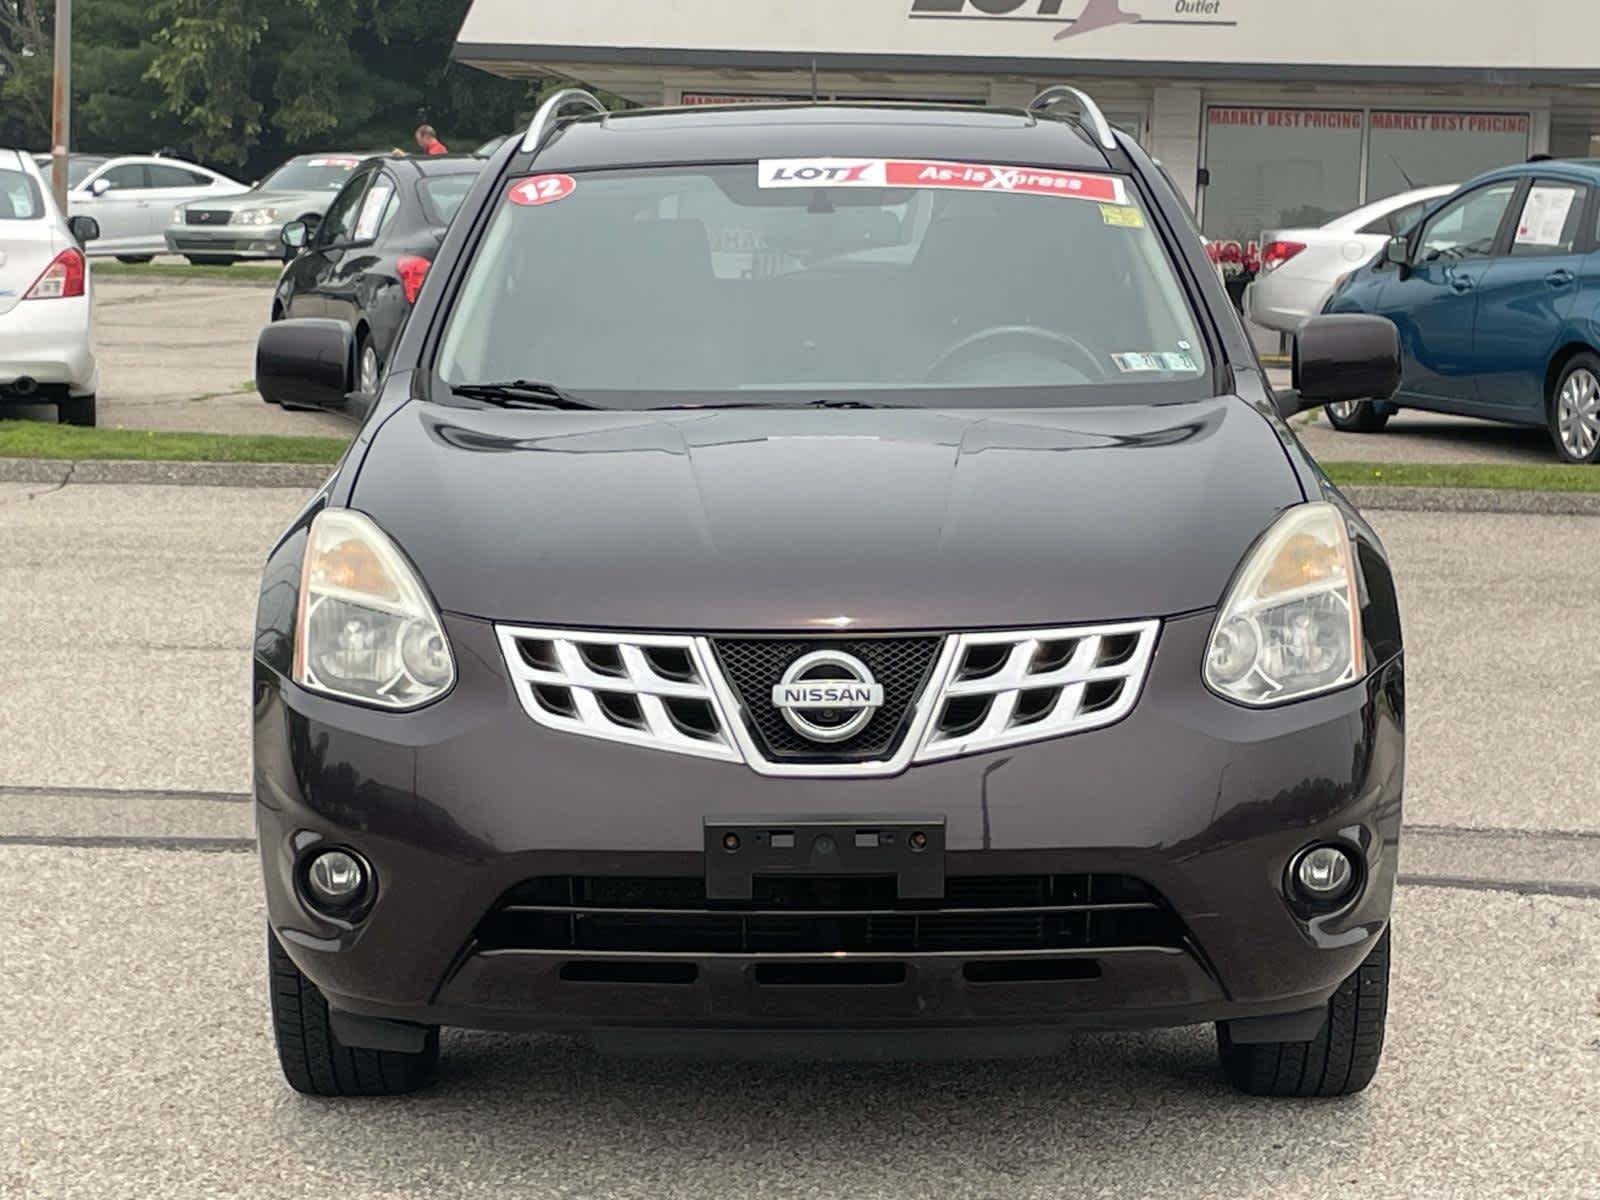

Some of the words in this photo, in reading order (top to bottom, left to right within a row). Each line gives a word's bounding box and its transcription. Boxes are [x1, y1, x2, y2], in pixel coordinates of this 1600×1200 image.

[1175, 0, 1220, 14] Outlet
[1210, 110, 1263, 127] MARKET
[1267, 111, 1300, 128] BEST
[1304, 112, 1361, 129] PRICING
[1371, 111, 1427, 130] MARKET
[1431, 113, 1466, 131] BEST
[1469, 114, 1527, 132] PRICING
[518, 178, 564, 202] 12
[784, 688, 871, 702] NISSAN
